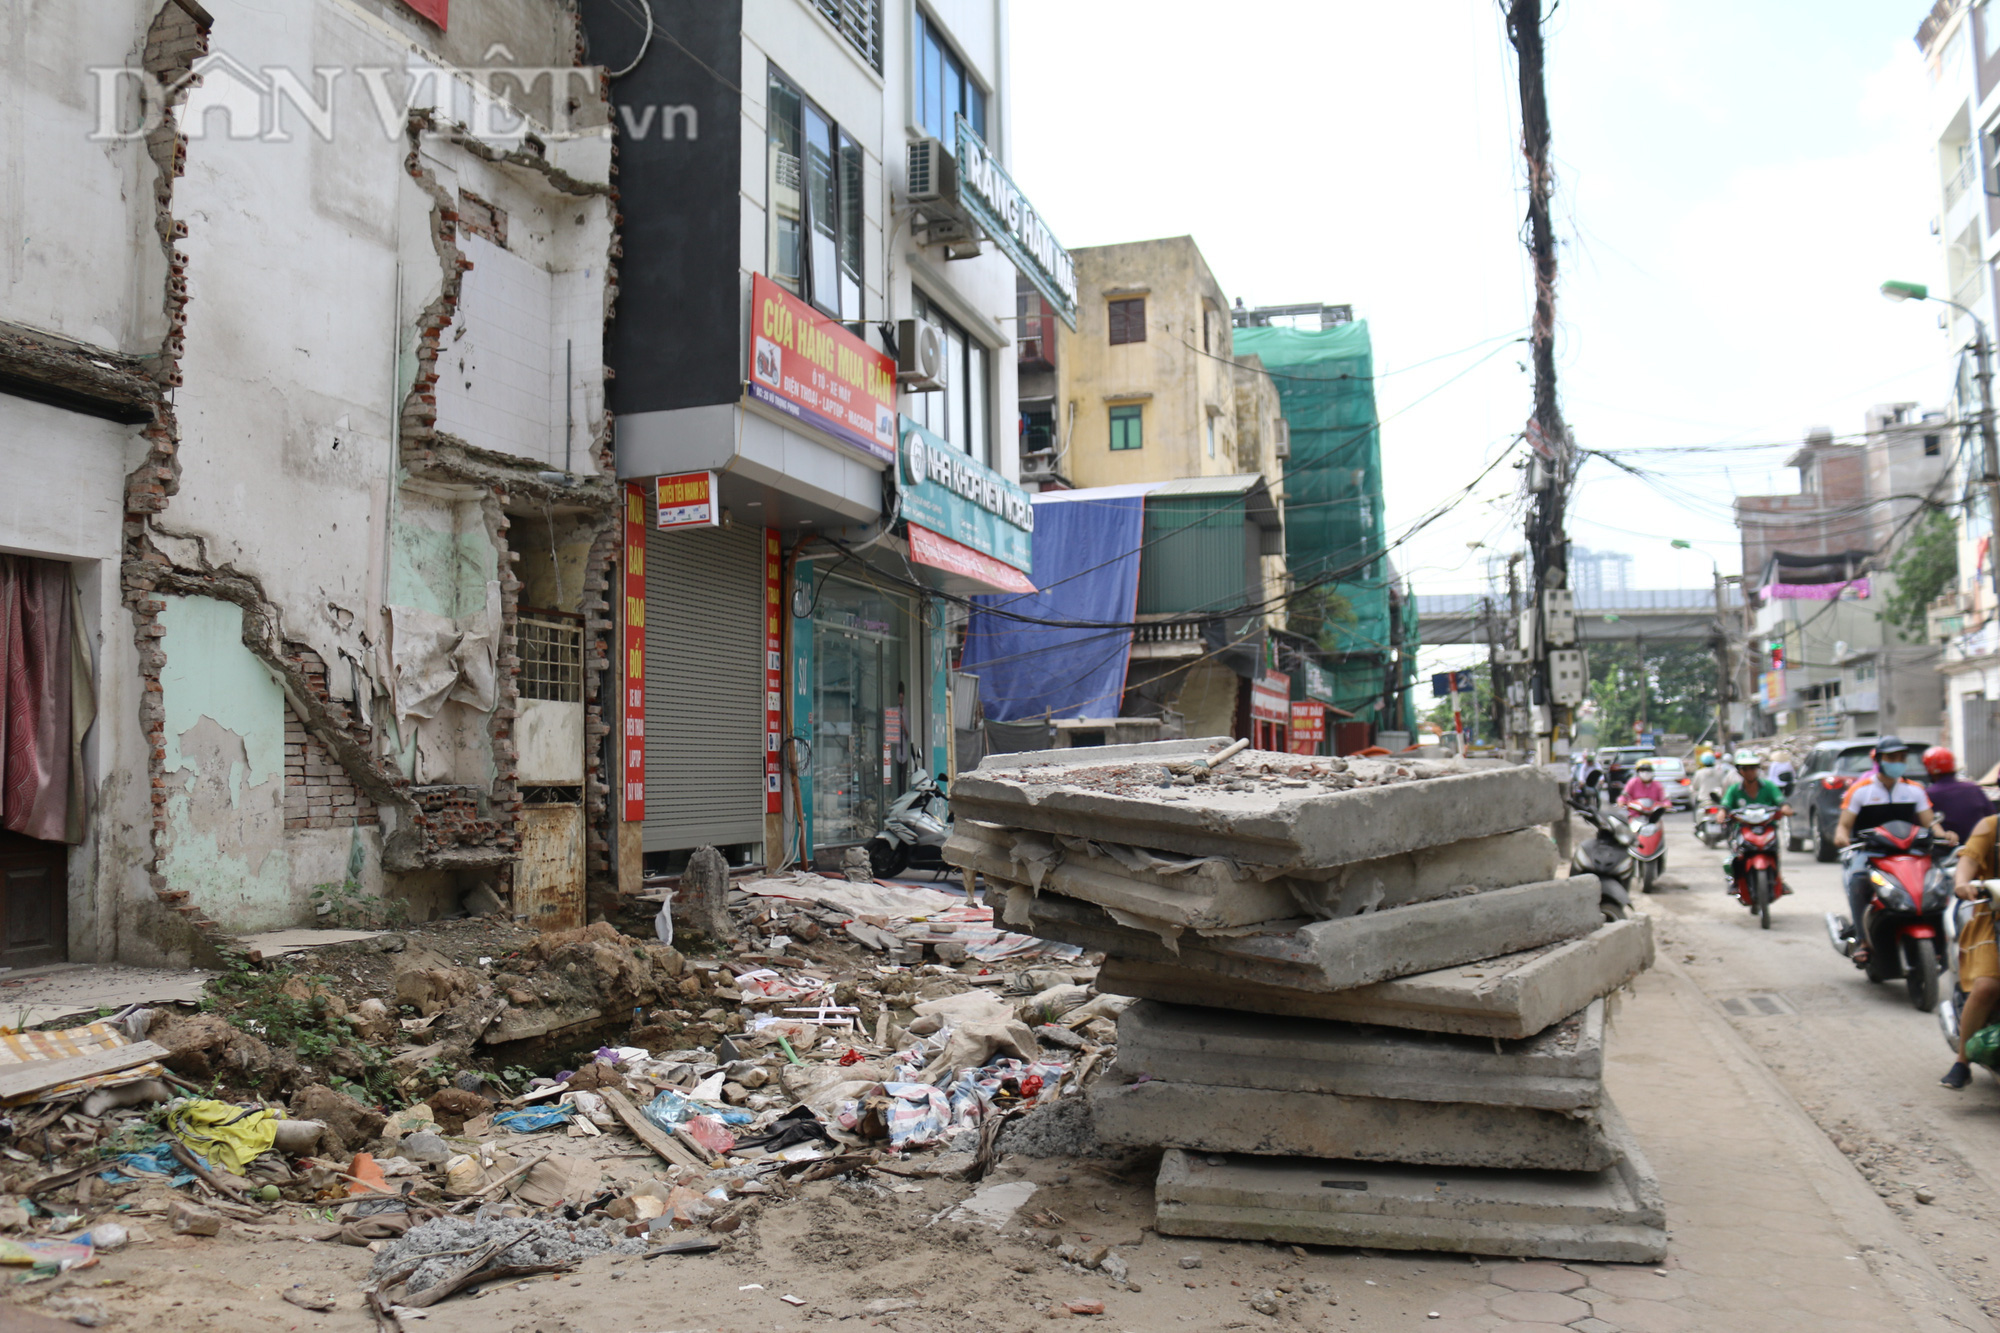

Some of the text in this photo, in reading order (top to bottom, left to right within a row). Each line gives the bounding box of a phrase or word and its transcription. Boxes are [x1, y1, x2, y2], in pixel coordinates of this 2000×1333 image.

[763, 293, 891, 405] CỬA HÀNG MUA BÁN
[784, 374, 799, 398] ĐIỆN
[800, 382, 818, 408] THOẠI
[822, 396, 844, 419] LAPTOP
[830, 380, 838, 398] XE
[628, 493, 644, 526] MUA
[981, 477, 1002, 516] NEW
[1004, 489, 1034, 532] WORLD
[628, 541, 643, 576] BÁN
[627, 596, 644, 628] TRAO
[629, 638, 642, 679] ĐỔI
